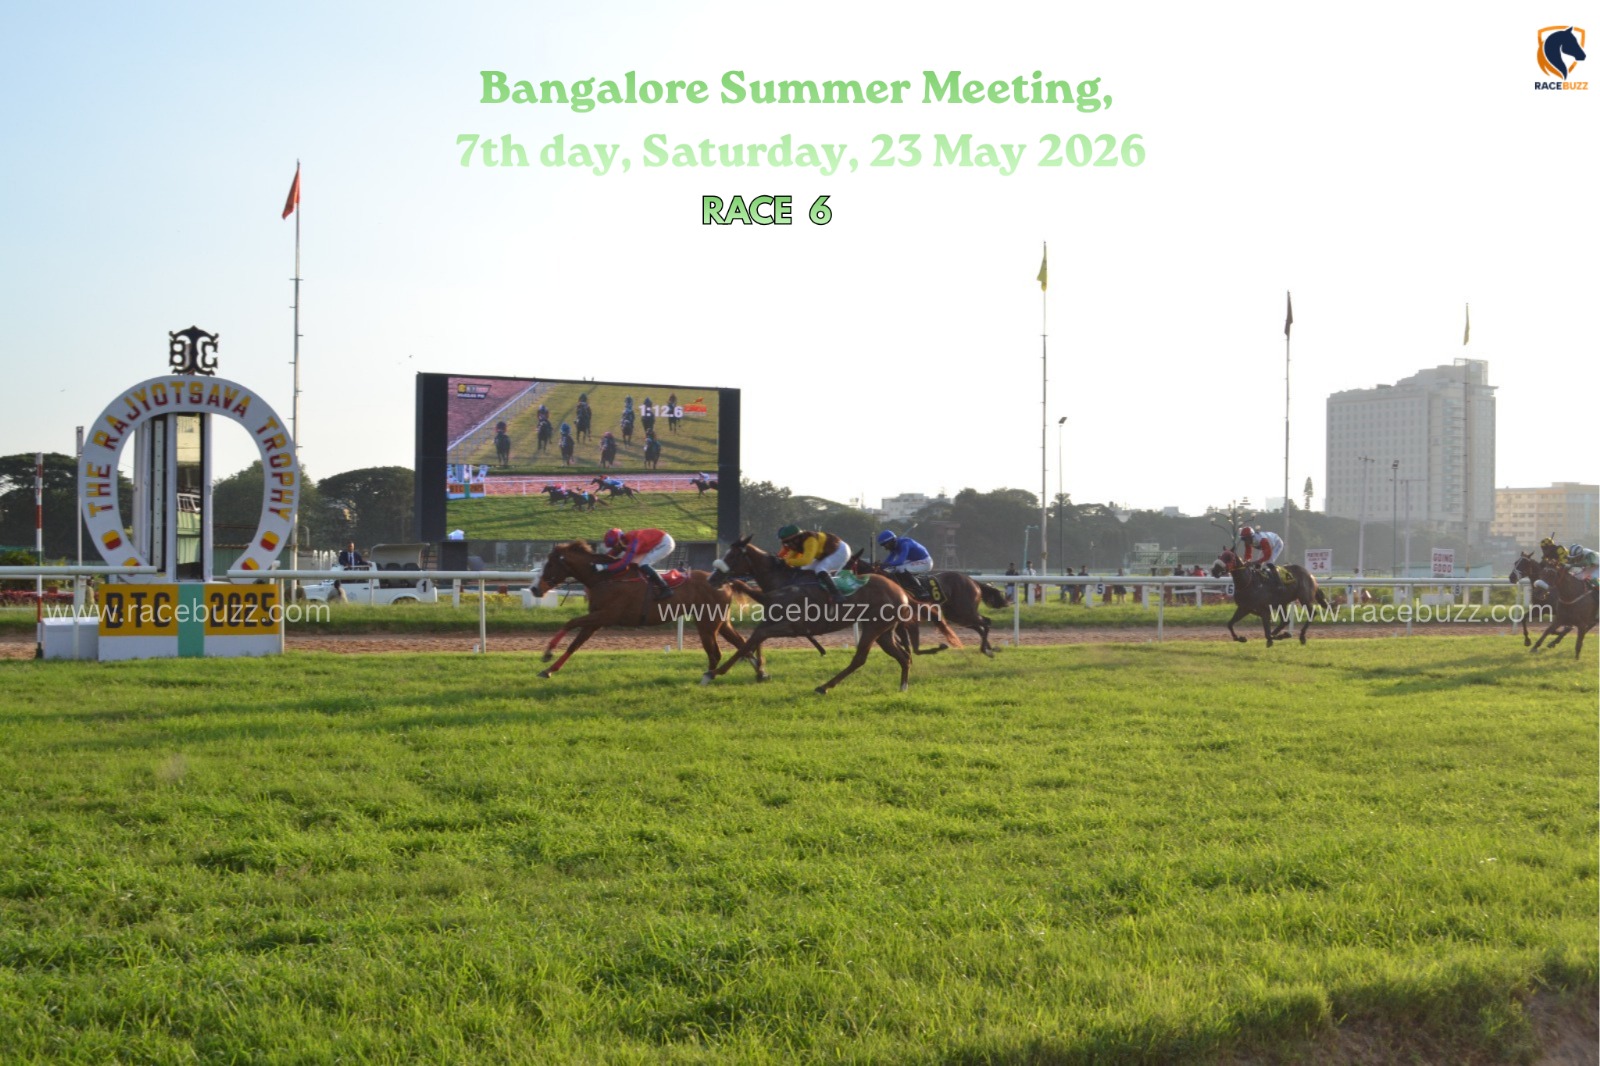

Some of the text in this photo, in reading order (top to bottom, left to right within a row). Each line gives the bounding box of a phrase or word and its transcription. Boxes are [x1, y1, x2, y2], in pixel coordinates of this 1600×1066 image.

[638, 404, 684, 418] 1:12.6
[86, 381, 295, 522] THE RAJYOTSAVA TROPHY
[1433, 553, 1453, 563] GOING
[1312, 561, 1325, 570] 34
[1433, 563, 1451, 573] GOOD
[420, 580, 427, 593] 1
[106, 592, 275, 628] BTC 2025
